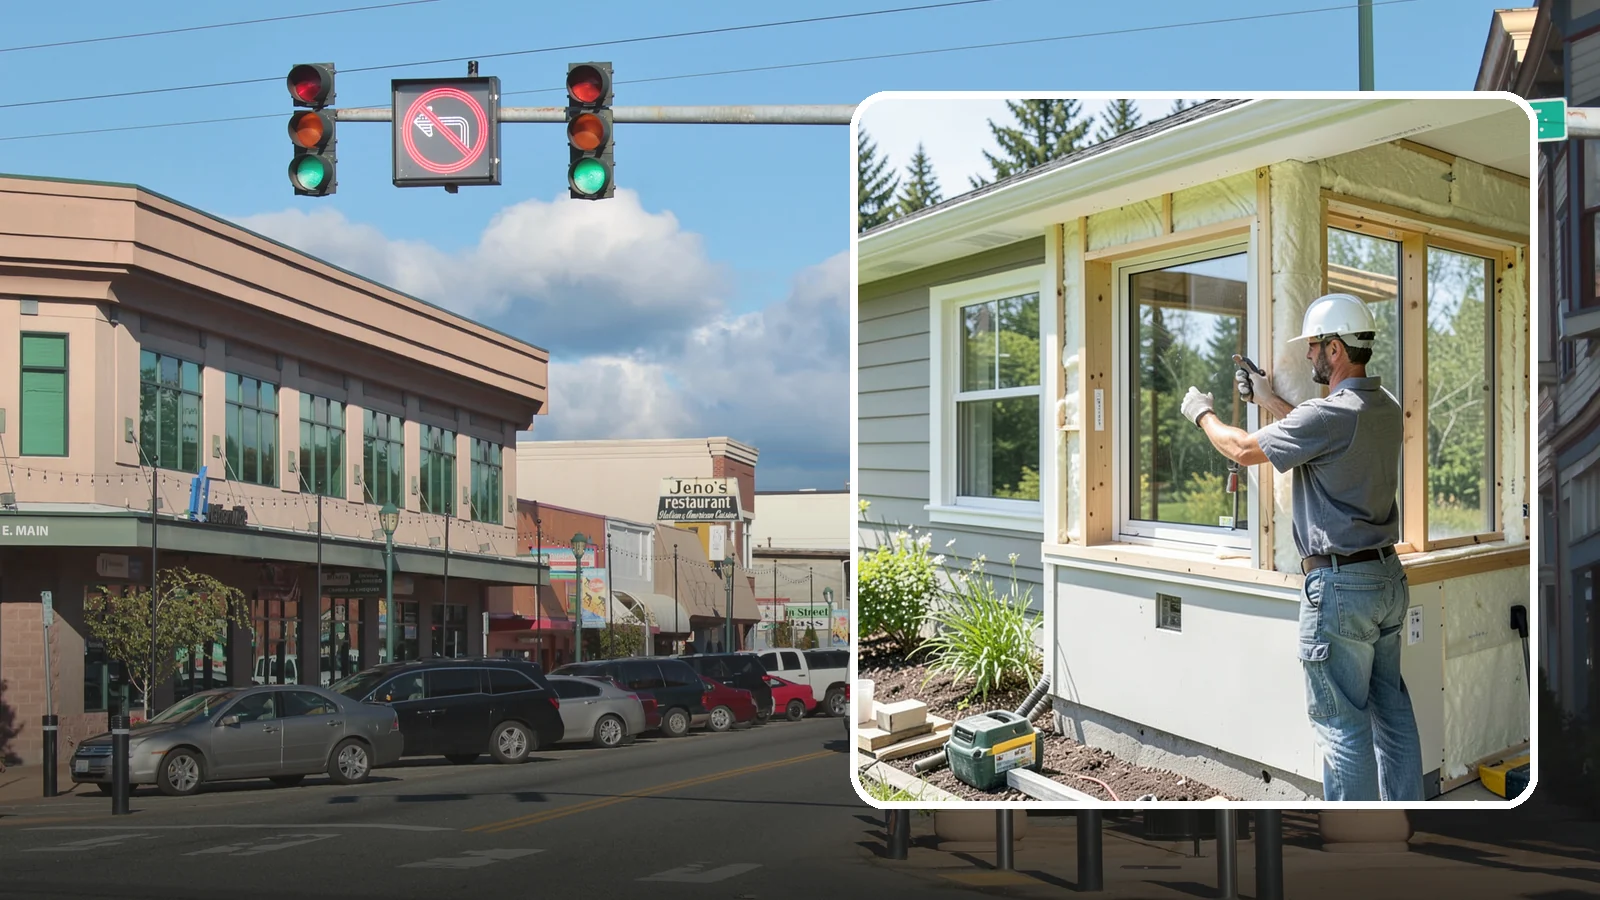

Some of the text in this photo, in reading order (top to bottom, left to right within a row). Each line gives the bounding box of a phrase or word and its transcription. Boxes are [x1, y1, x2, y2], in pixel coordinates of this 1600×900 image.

[670, 480, 727, 494] Jeno's
[665, 496, 731, 508] restaurant
[658, 510, 681, 519] Italian
[686, 509, 715, 519] American
[715, 509, 737, 519] Cuisine
[2, 525, 49, 536] E. MAIN
[797, 608, 828, 616] Street
